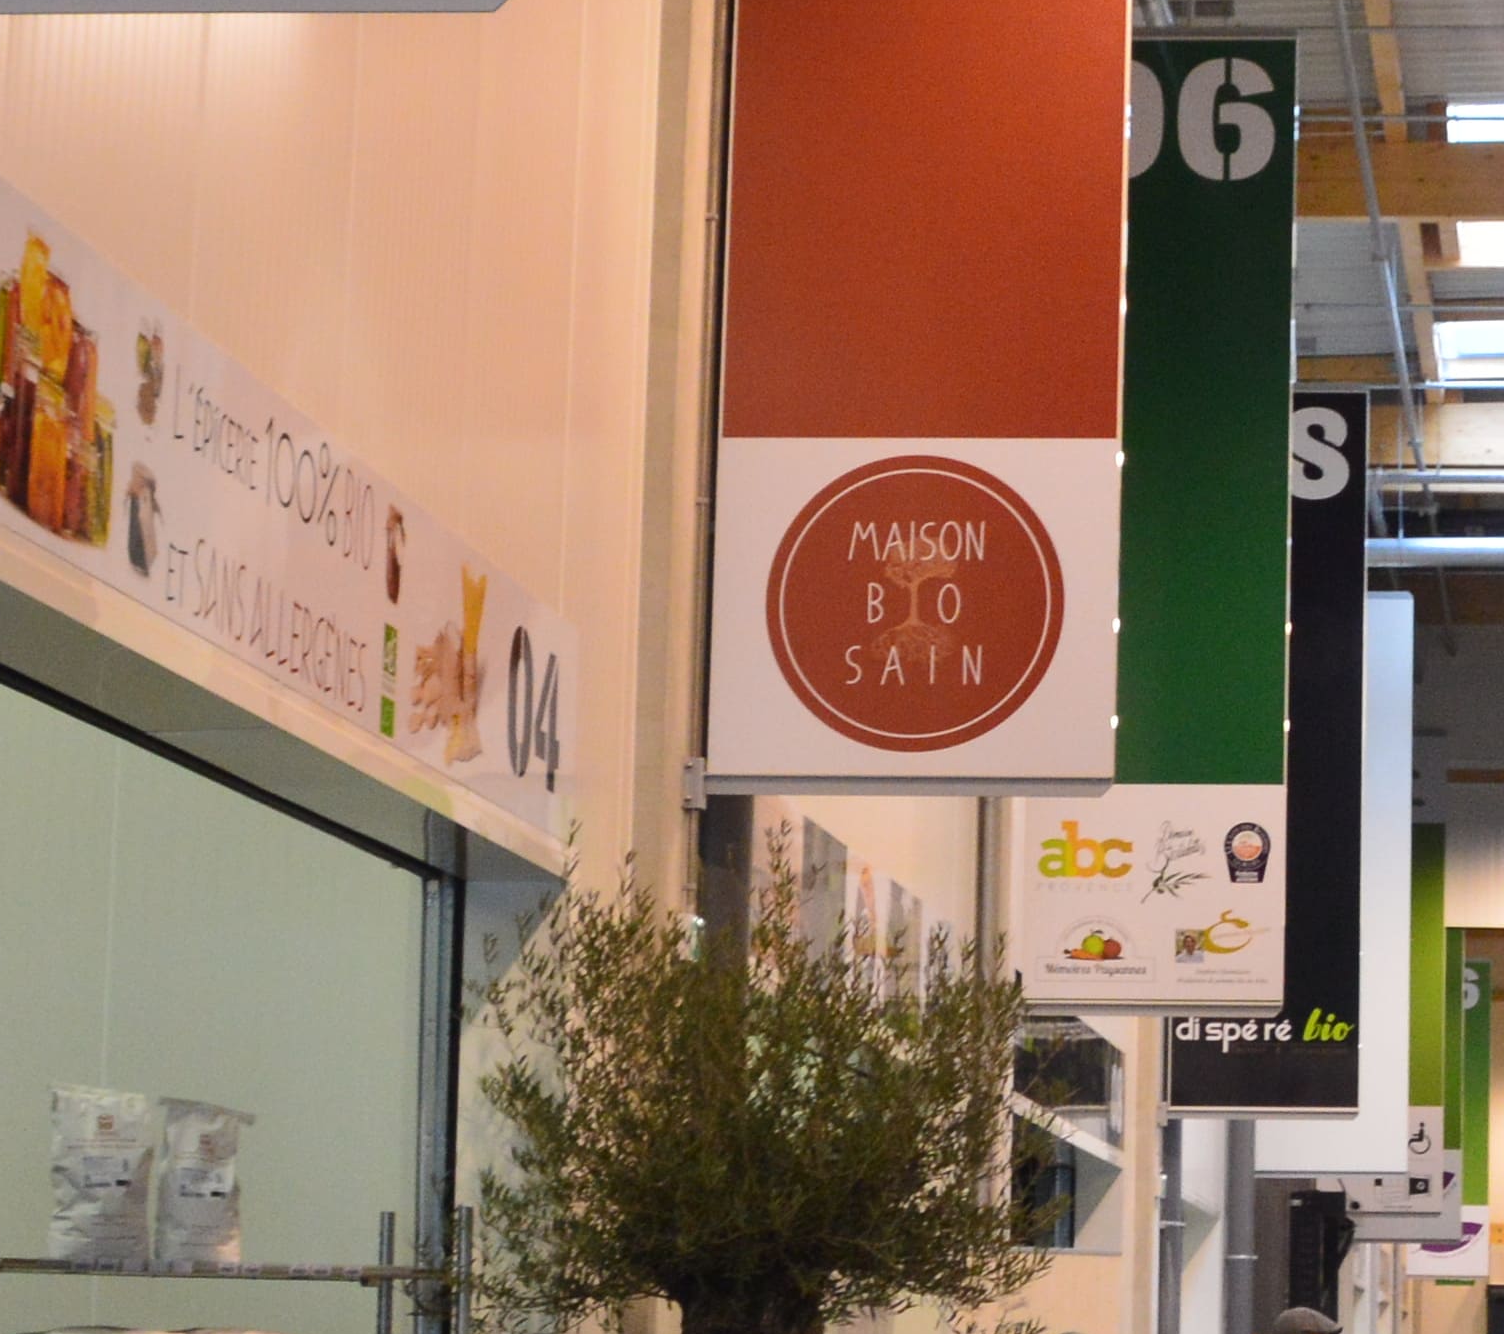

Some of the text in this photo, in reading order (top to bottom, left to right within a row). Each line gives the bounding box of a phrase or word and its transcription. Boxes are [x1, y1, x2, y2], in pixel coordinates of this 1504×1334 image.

[848, 520, 986, 564] MAISON
[166, 542, 189, 609] ET
[194, 538, 246, 642] SANS
[844, 644, 983, 687] SAIN
[508, 625, 561, 794] 04
[1038, 819, 1134, 879] abc
[1303, 1007, 1355, 1042] bio
